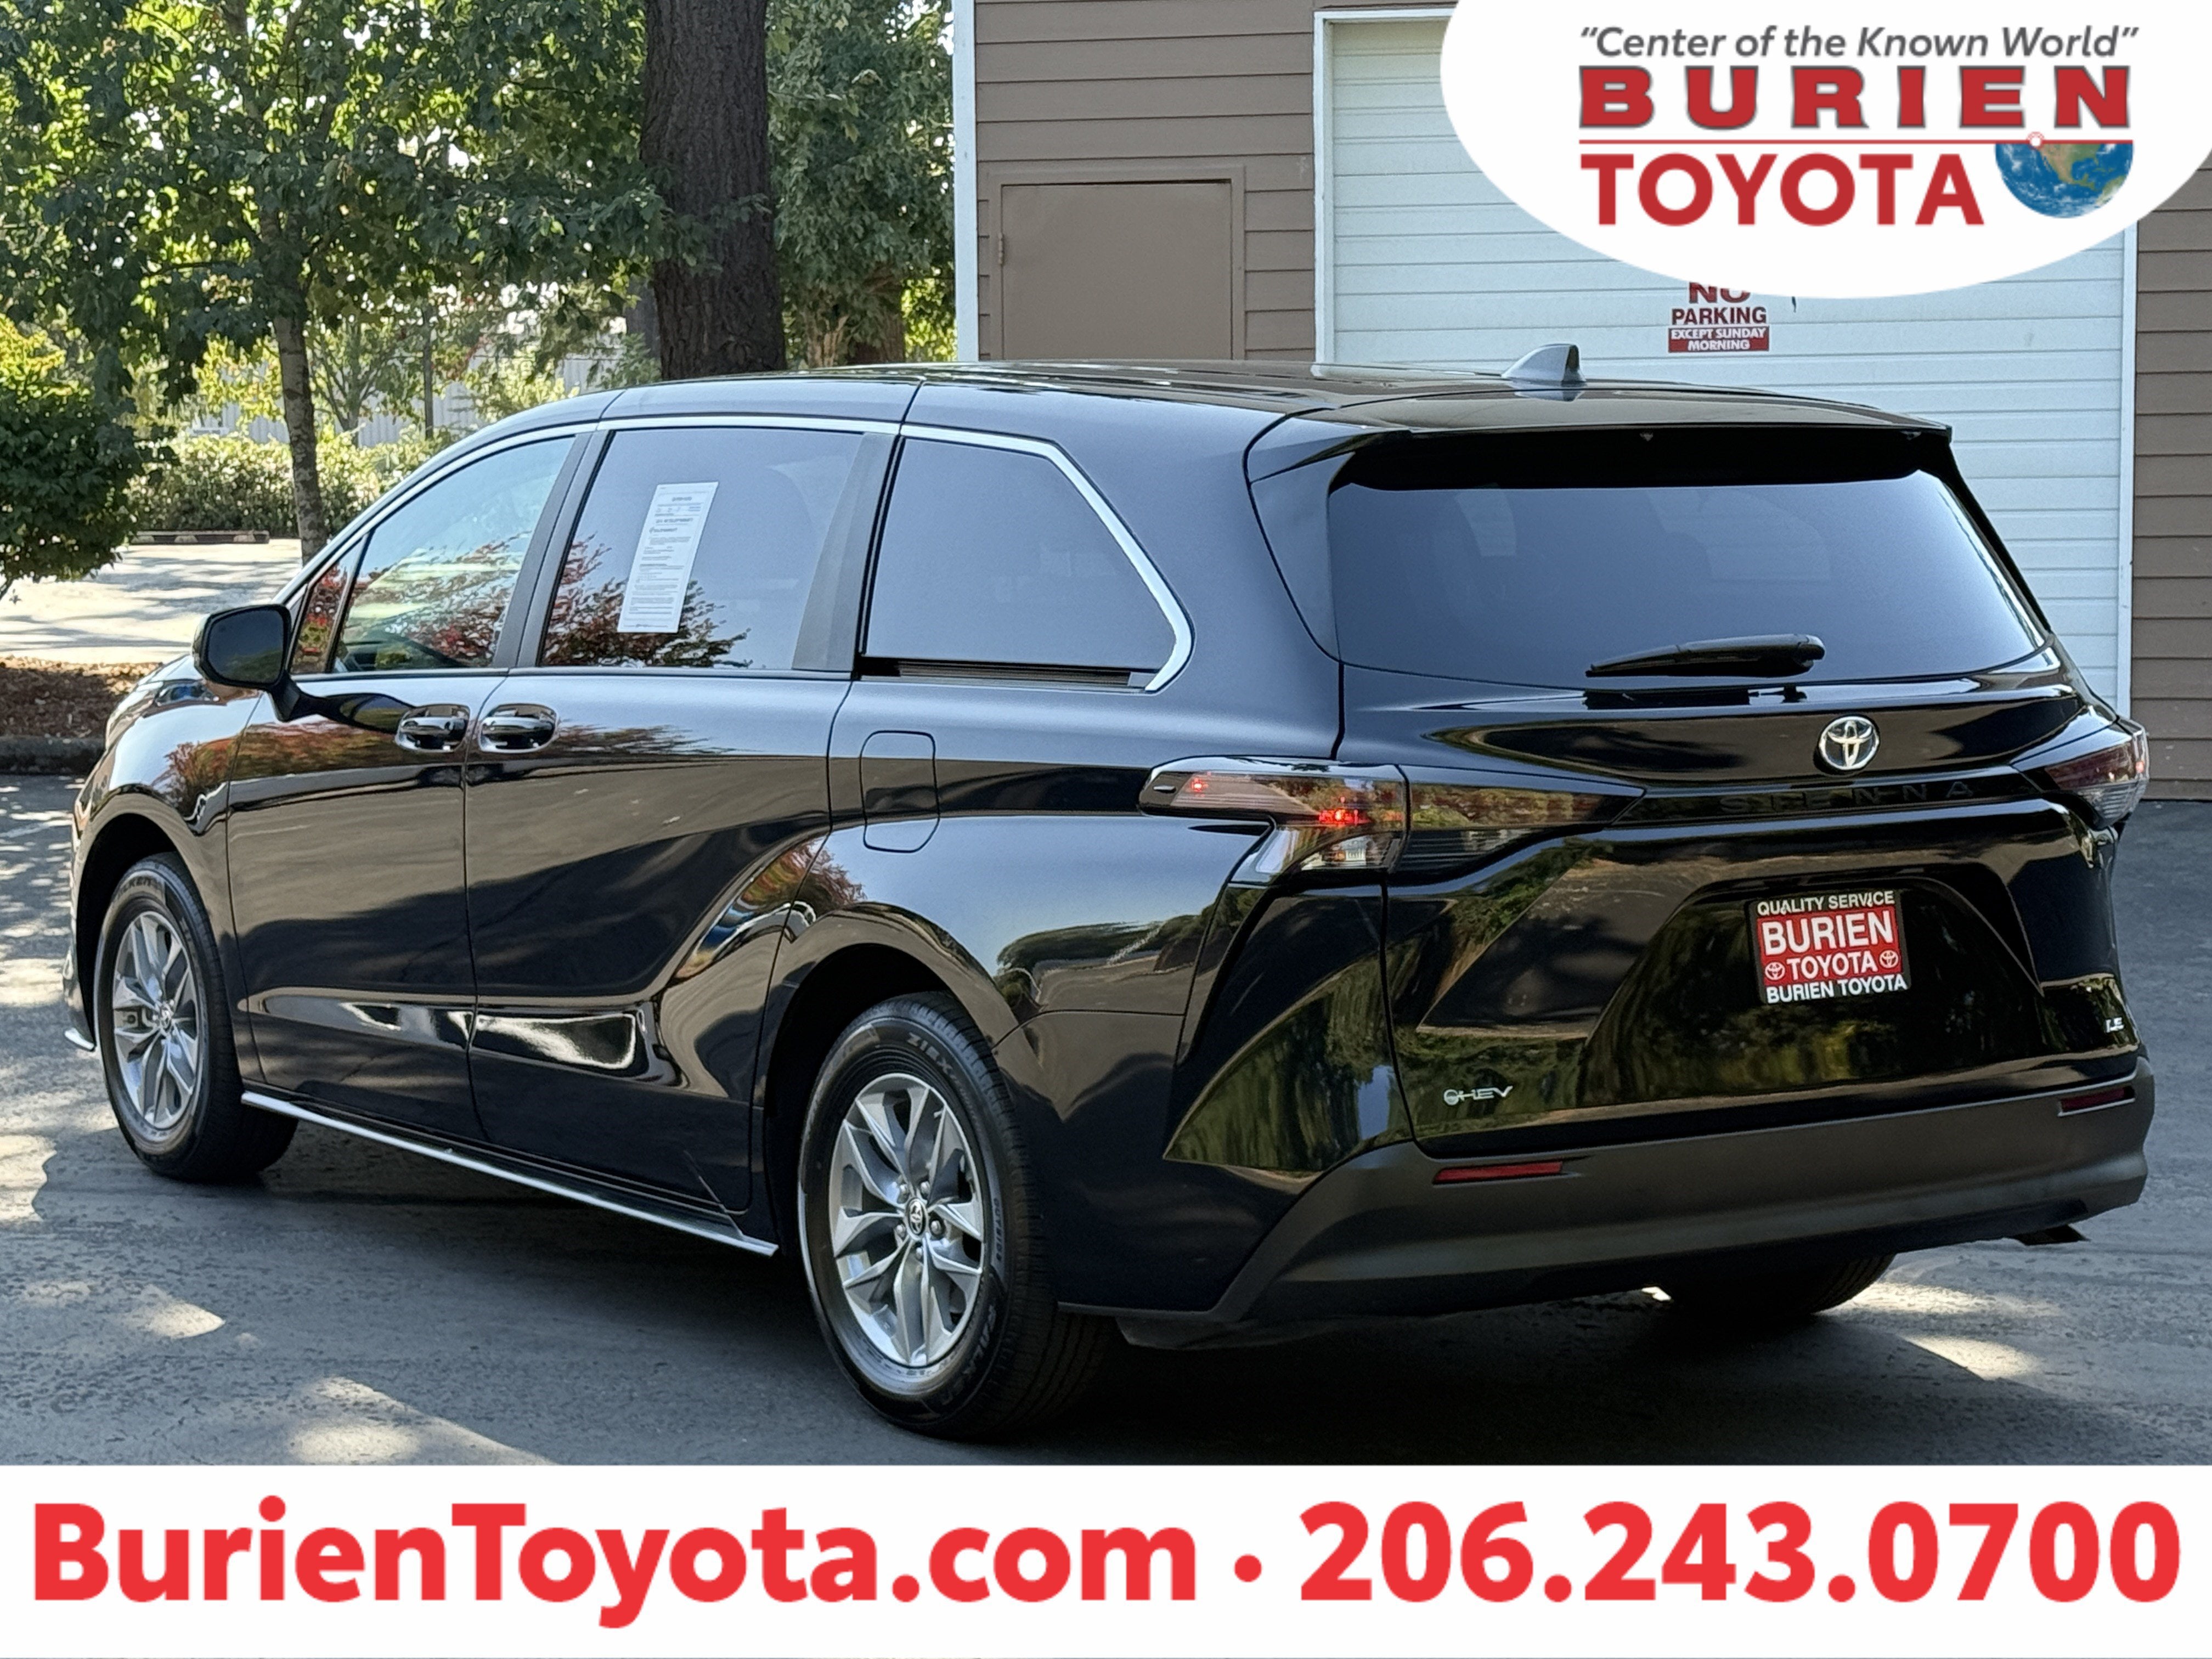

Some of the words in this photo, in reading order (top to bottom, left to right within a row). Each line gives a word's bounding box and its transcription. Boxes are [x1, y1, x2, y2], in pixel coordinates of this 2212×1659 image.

[1672, 306, 1767, 325] PARKING
[1671, 329, 1713, 340] EXCEPT
[1715, 328, 1766, 338] SUNDAY
[1688, 339, 1750, 351] MORNING
[1757, 896, 1824, 916] QUALITY
[1828, 890, 1895, 909] SERVICE
[1762, 910, 1893, 956] BURIEN
[1787, 951, 1878, 980] TOYOTA
[1766, 981, 1835, 1004] BURIEN
[1837, 973, 1908, 996] TOYOTA
[2106, 1017, 2124, 1033] LE
